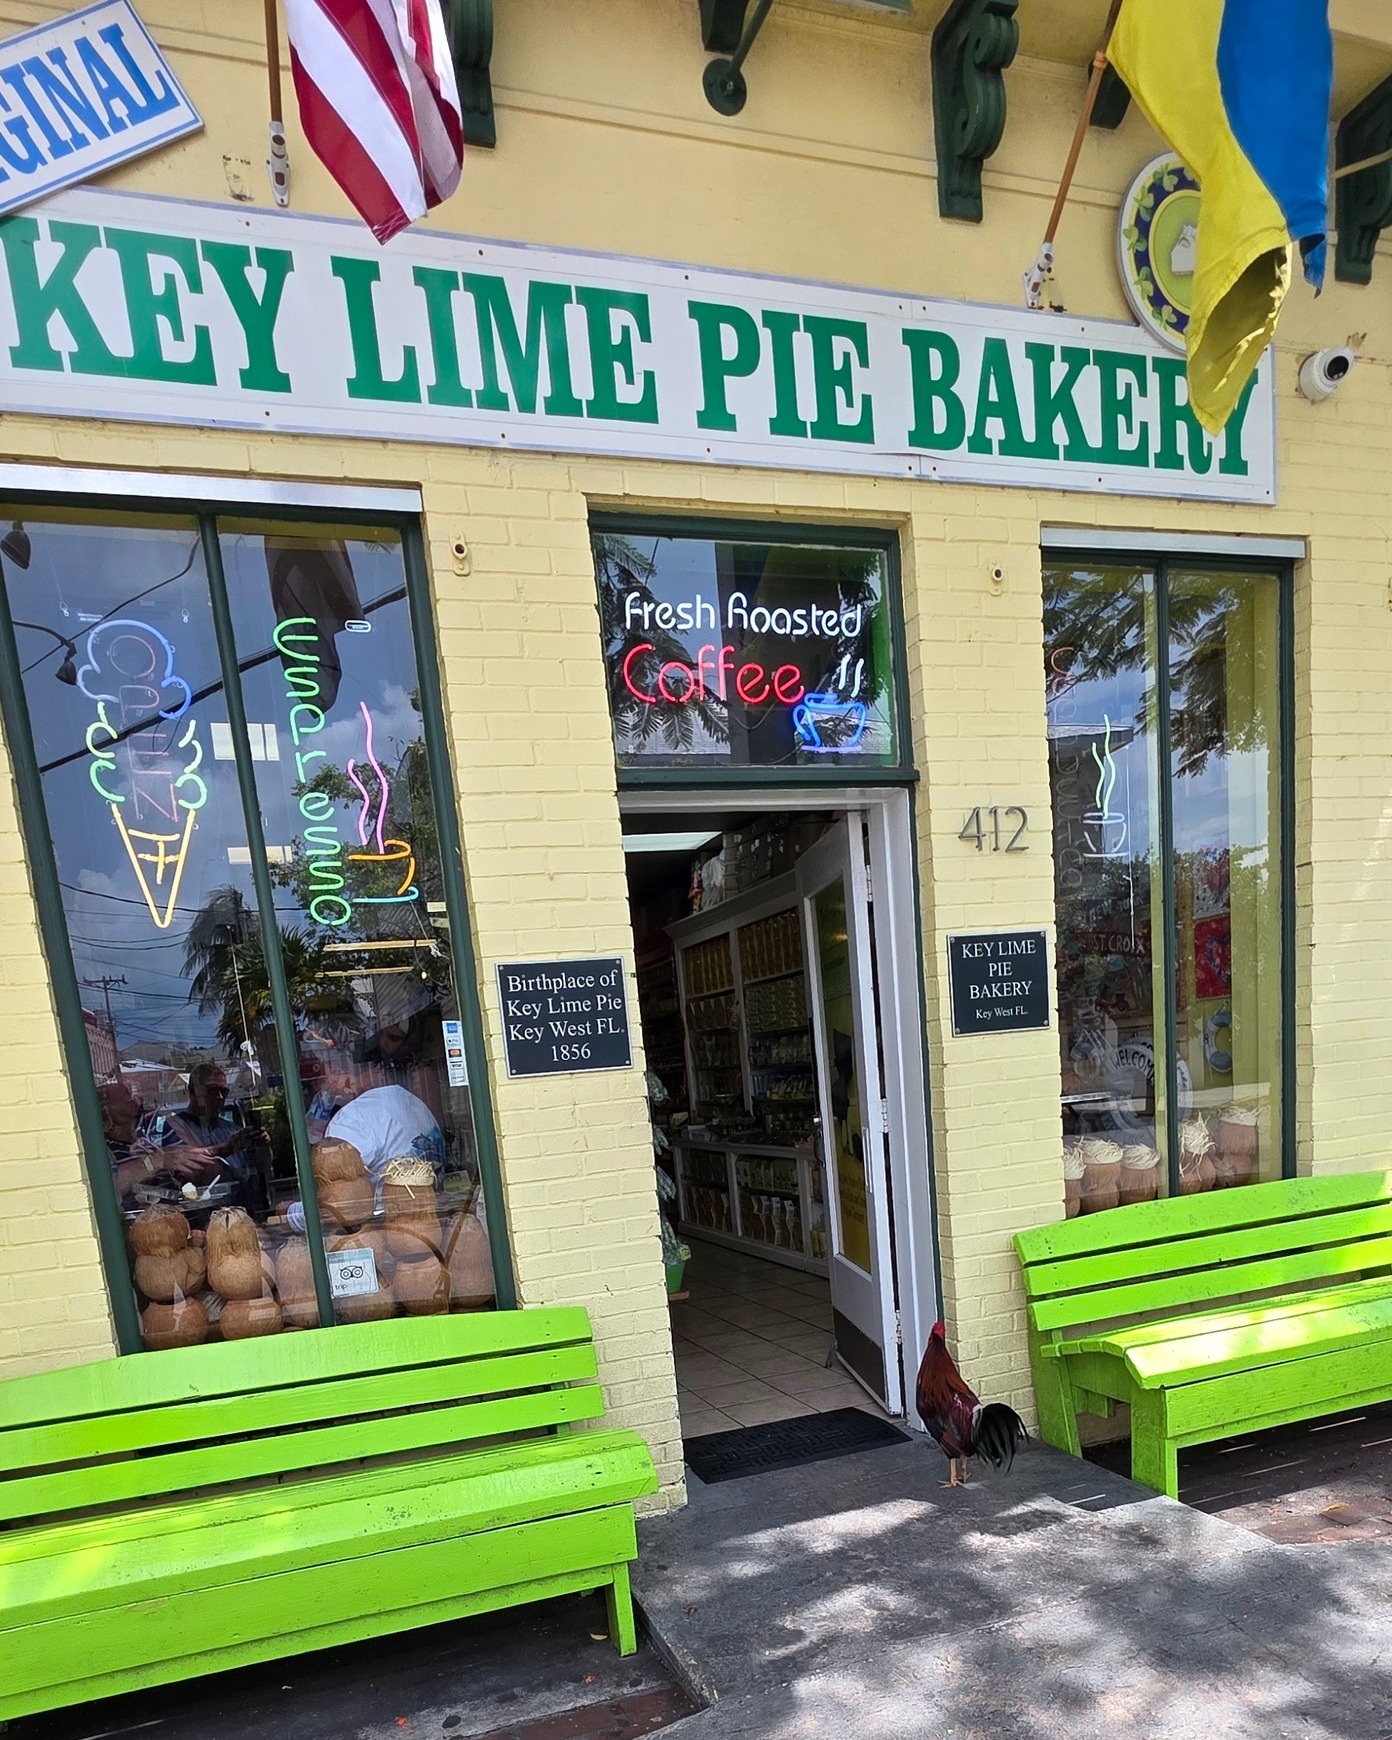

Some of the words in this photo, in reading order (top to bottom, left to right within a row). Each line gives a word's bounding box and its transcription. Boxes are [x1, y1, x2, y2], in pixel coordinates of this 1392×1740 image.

[0, 215, 294, 393] KEY
[330, 255, 659, 425] LIME
[688, 300, 875, 444] PIE
[901, 328, 1259, 476] BAKERY
[625, 592, 715, 630] Fresh
[728, 592, 862, 637] Roasted
[623, 643, 805, 703] Coffee
[109, 634, 180, 823] OPEN
[958, 806, 1029, 853] 412
[962, 942, 995, 958] KEY
[998, 940, 1037, 956] LIME
[507, 972, 595, 994] Birthplace
[600, 969, 618, 986] of
[989, 962, 1013, 977] PIE
[969, 981, 1033, 999] BAKERY
[507, 1000, 542, 1019] Key
[547, 996, 592, 1014] Lime
[596, 993, 622, 1011] Pie
[976, 1009, 992, 1020] Key
[994, 1007, 1013, 1017] West
[509, 1024, 544, 1043] Key
[548, 1020, 592, 1038] West
[596, 1017, 625, 1035] FL.
[552, 1042, 591, 1062] 1856
[1110, 1048, 1155, 1084] WELCOM
